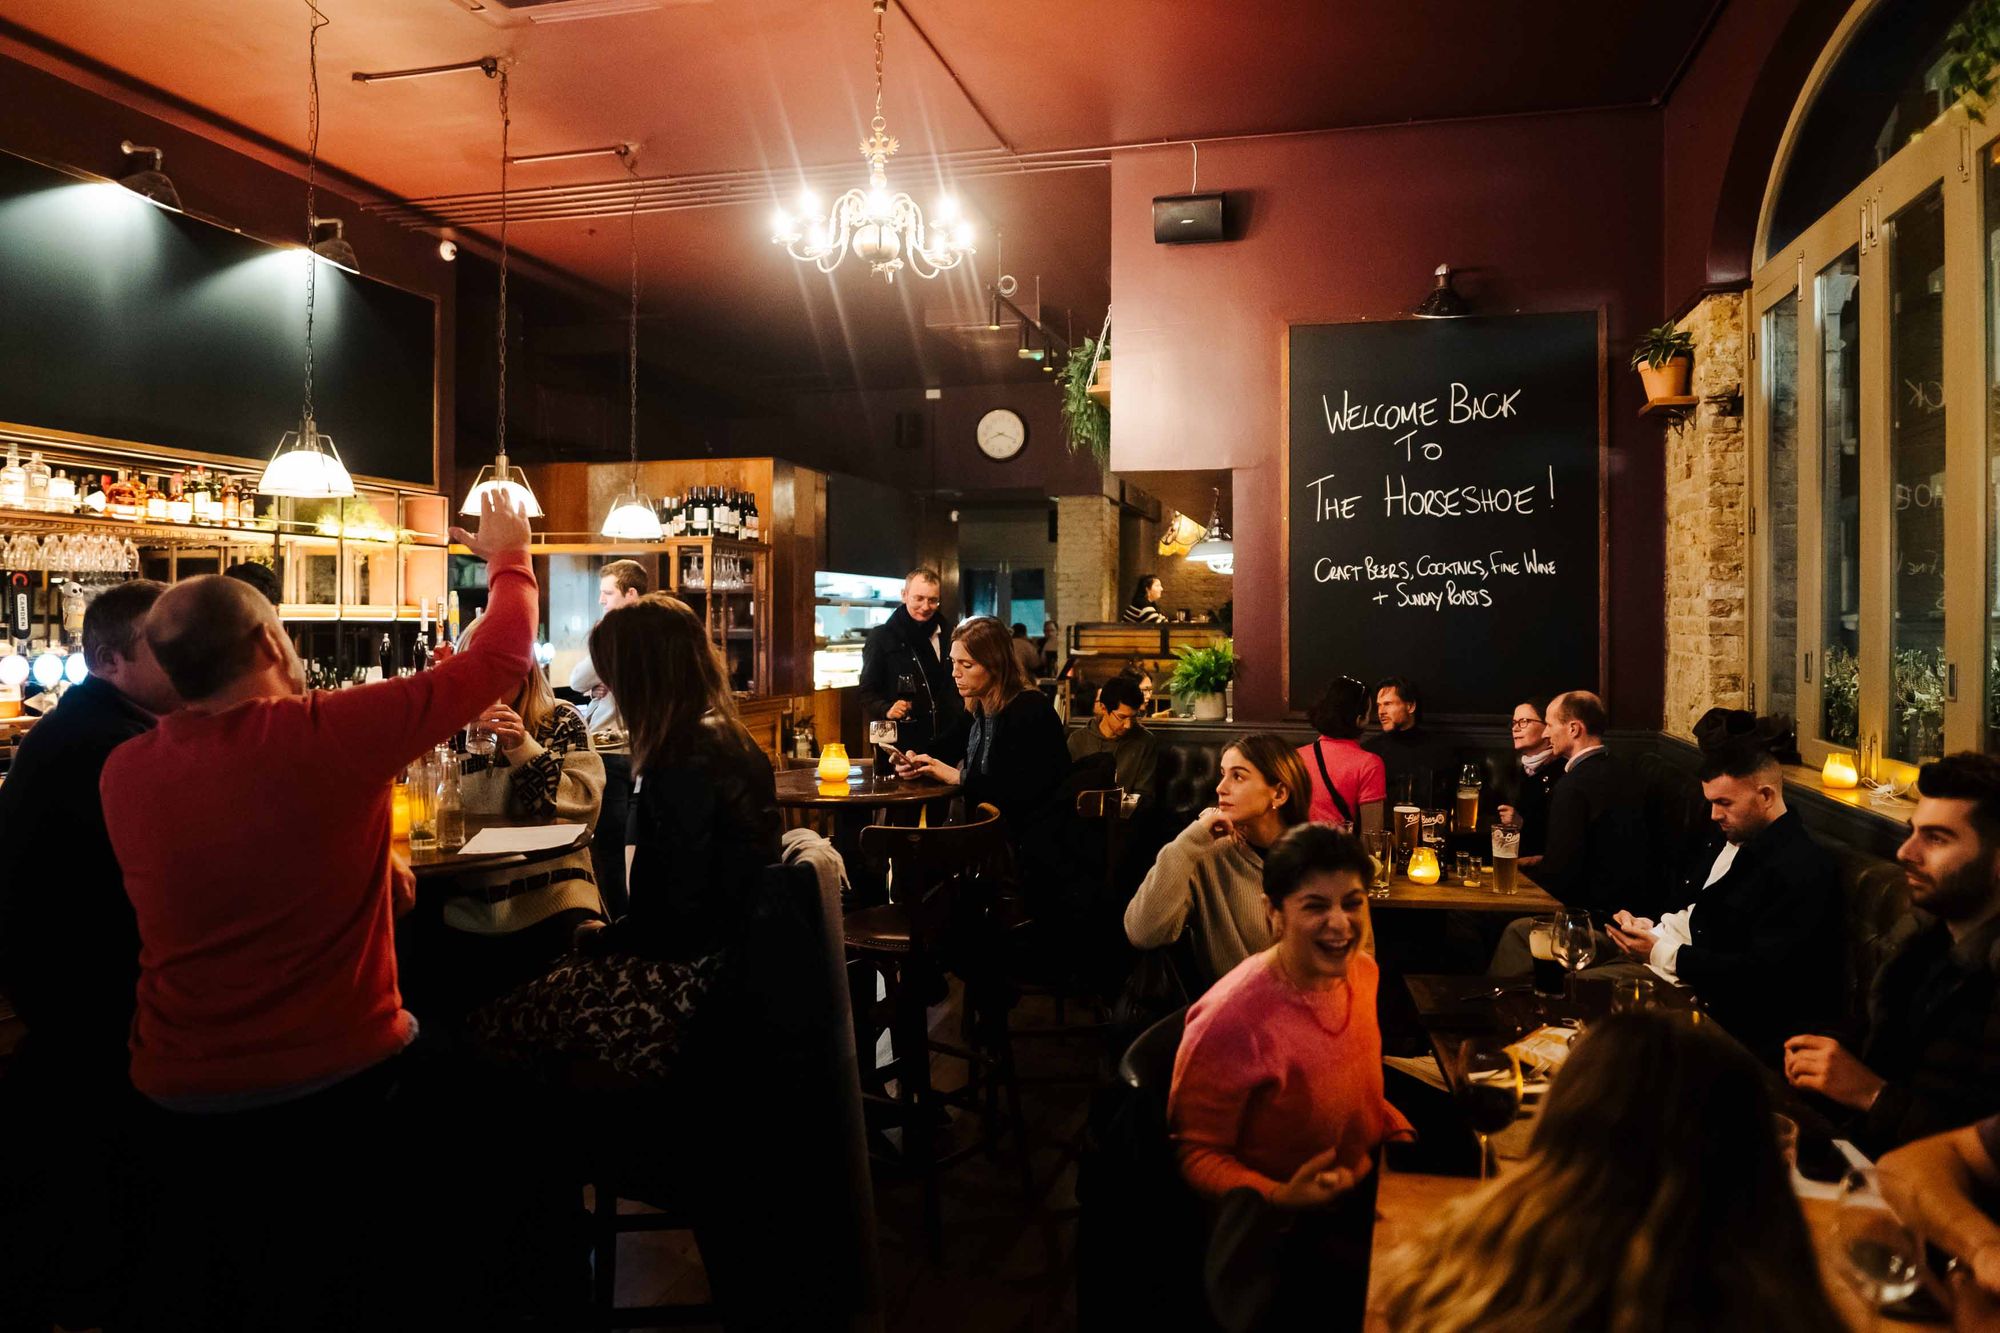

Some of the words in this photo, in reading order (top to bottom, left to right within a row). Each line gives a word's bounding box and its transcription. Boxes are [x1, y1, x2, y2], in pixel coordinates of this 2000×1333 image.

[1322, 389, 1439, 435] WELCOME
[1448, 382, 1521, 424] BACK
[1393, 429, 1443, 462] TO
[1305, 473, 1363, 523] THE
[1383, 474, 1536, 518] HORSESHOE
[1313, 557, 1364, 583] CRAFT
[1364, 555, 1415, 581] BEERS,
[1416, 554, 1489, 581] COCKTAILS,
[1488, 550, 1521, 576] FINE
[1523, 548, 1556, 575] WINE
[19, 596, 27, 627] CAMDEN
[1395, 581, 1444, 612] SUNDAY
[1445, 579, 1493, 608] ROASTS
